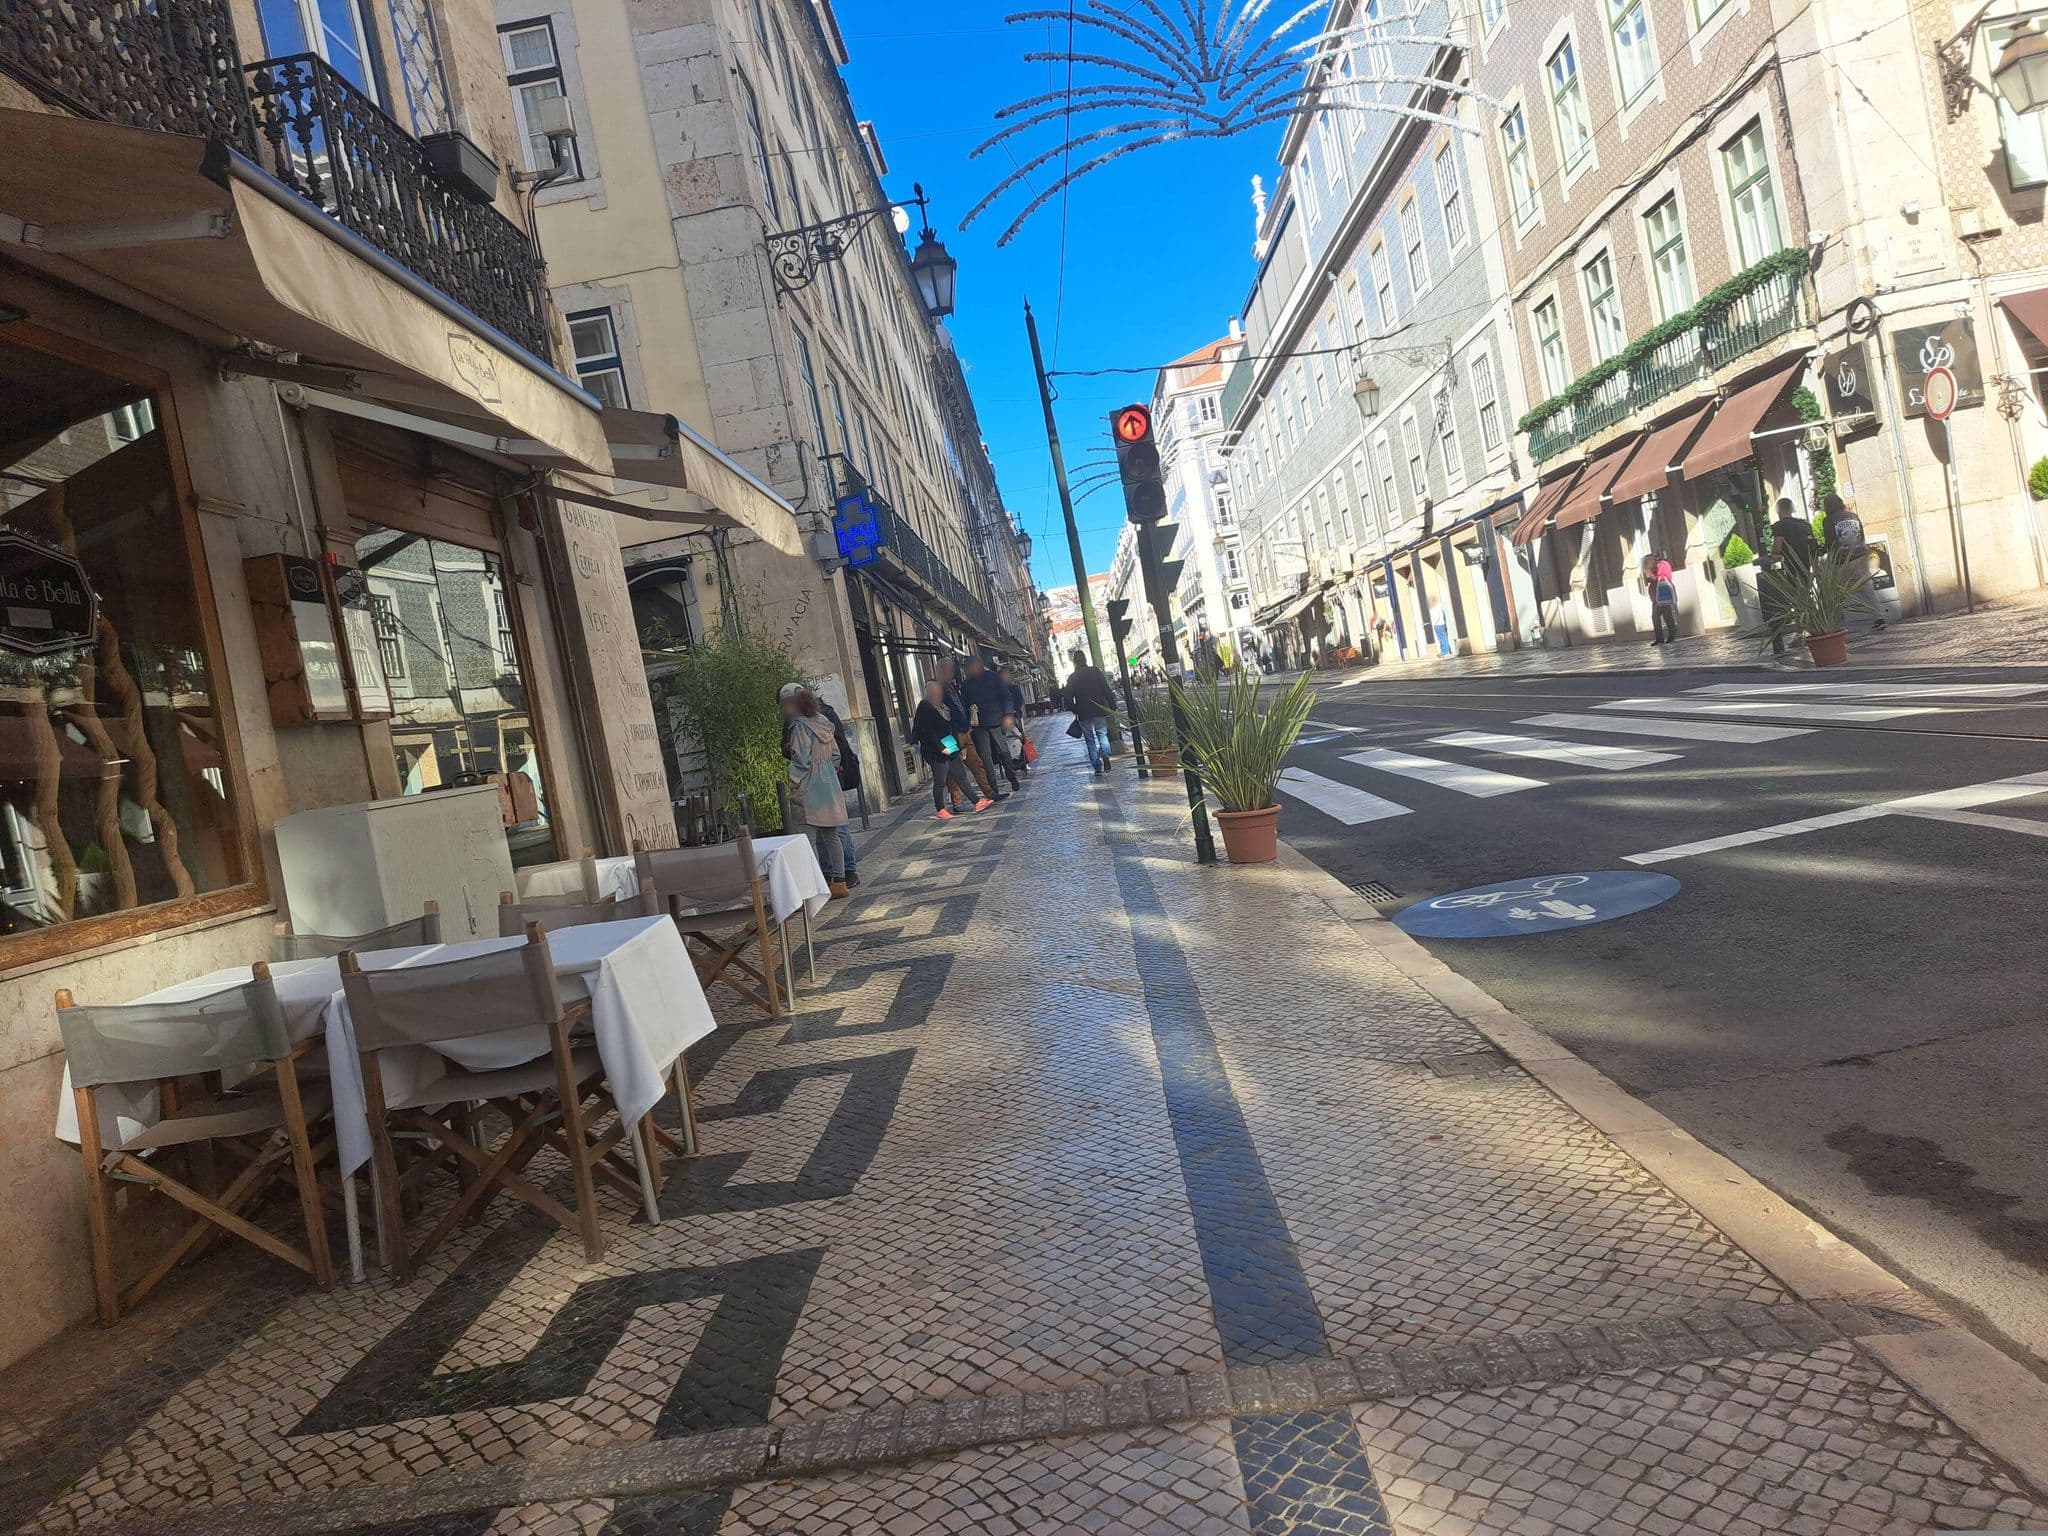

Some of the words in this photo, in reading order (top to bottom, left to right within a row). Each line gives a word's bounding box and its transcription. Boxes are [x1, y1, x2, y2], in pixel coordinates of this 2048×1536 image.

[25, 576, 38, 600] è
[41, 579, 81, 605] Bella
[778, 588, 815, 654] RMACIA
